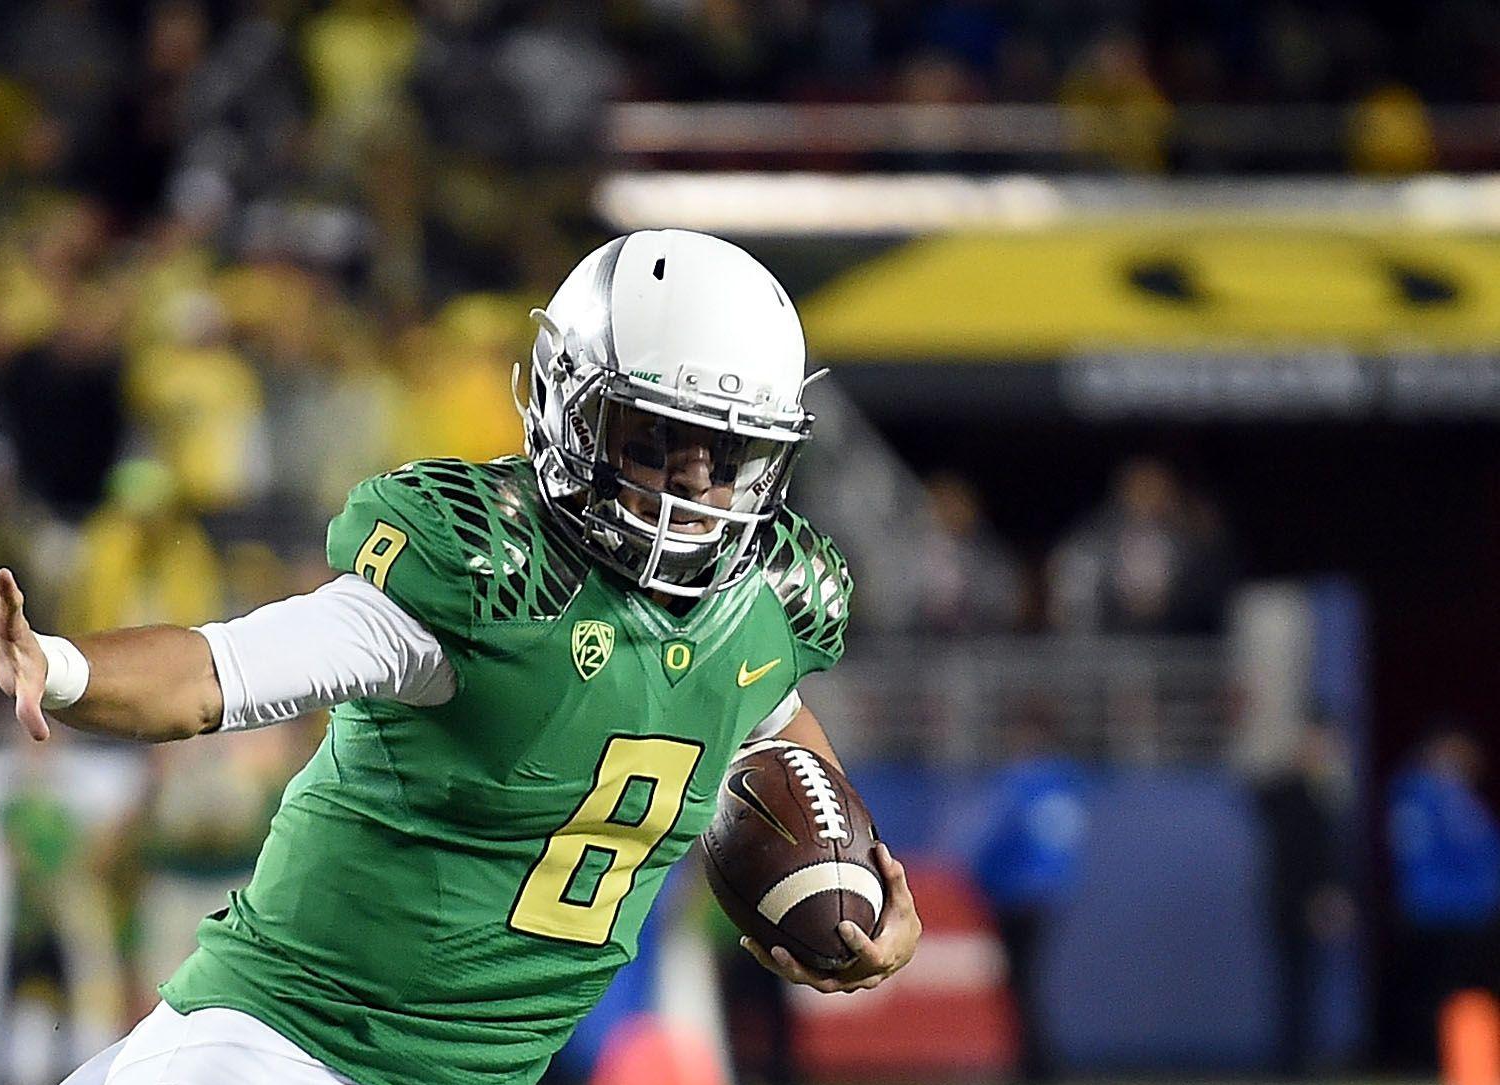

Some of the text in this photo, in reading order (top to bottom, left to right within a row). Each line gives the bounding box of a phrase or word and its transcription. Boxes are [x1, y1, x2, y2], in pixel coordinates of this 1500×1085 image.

[575, 622, 614, 660] PAC
[579, 645, 603, 669] 12
[666, 643, 691, 670] O
[506, 734, 705, 948] 8
